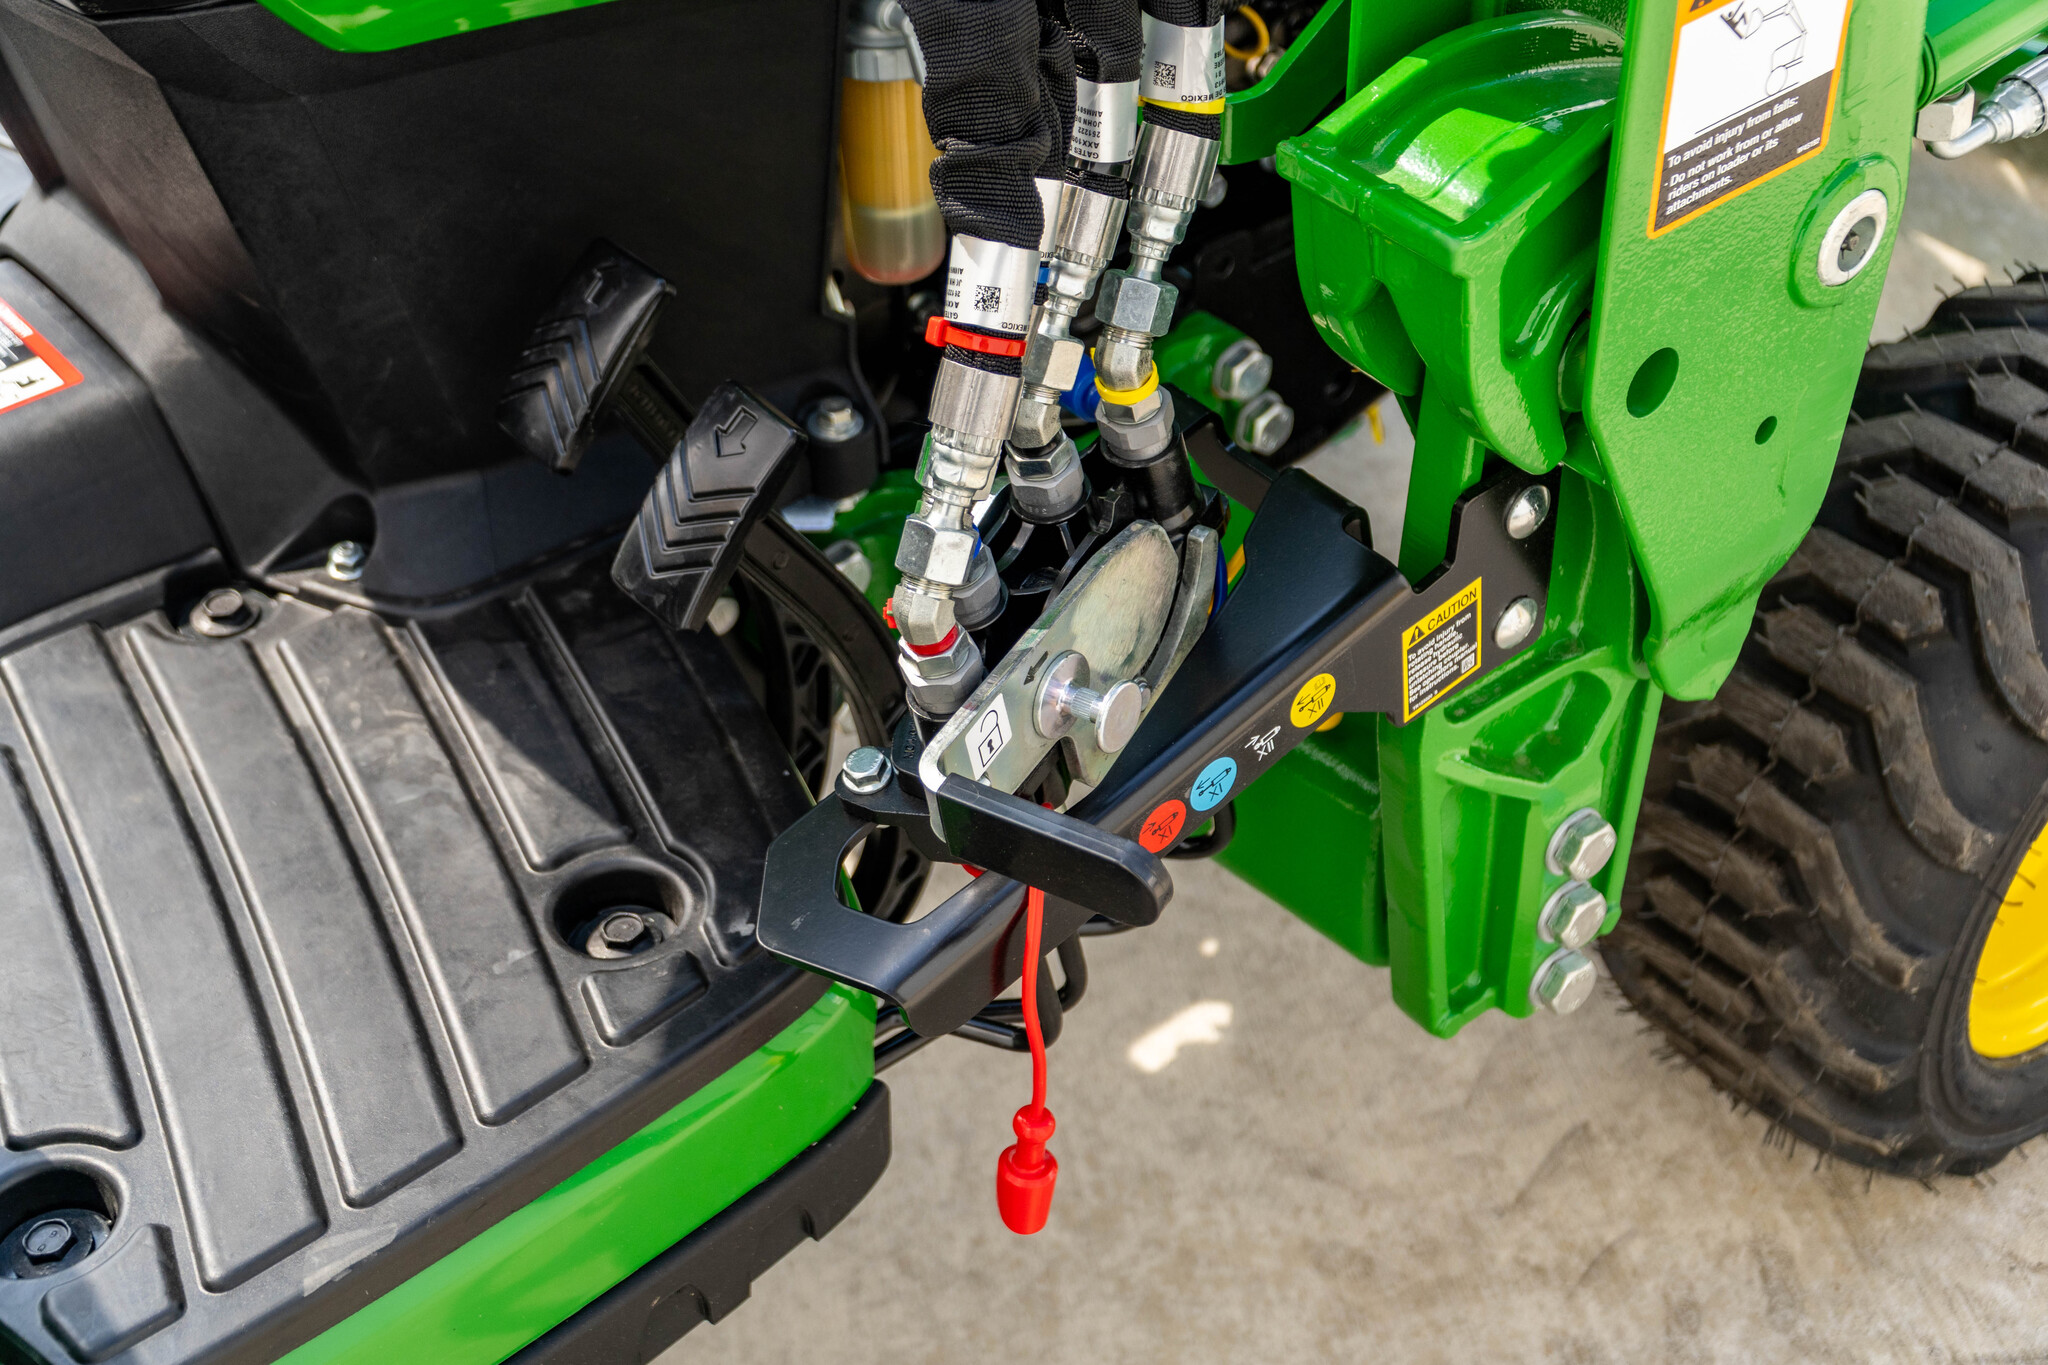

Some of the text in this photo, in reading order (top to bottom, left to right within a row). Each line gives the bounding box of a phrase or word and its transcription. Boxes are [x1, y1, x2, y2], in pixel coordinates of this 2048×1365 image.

[1181, 93, 1214, 102] MEXICO
[1083, 117, 1102, 128] JOHN
[1668, 96, 1799, 168] To avoid injury from falls:
[1074, 146, 1099, 159] GATES
[1667, 138, 1779, 201] riders on loader or its
[1670, 113, 1803, 187] Do not work from or allow
[1666, 176, 1732, 215] attachments.
[1428, 588, 1476, 630] CAUTION
